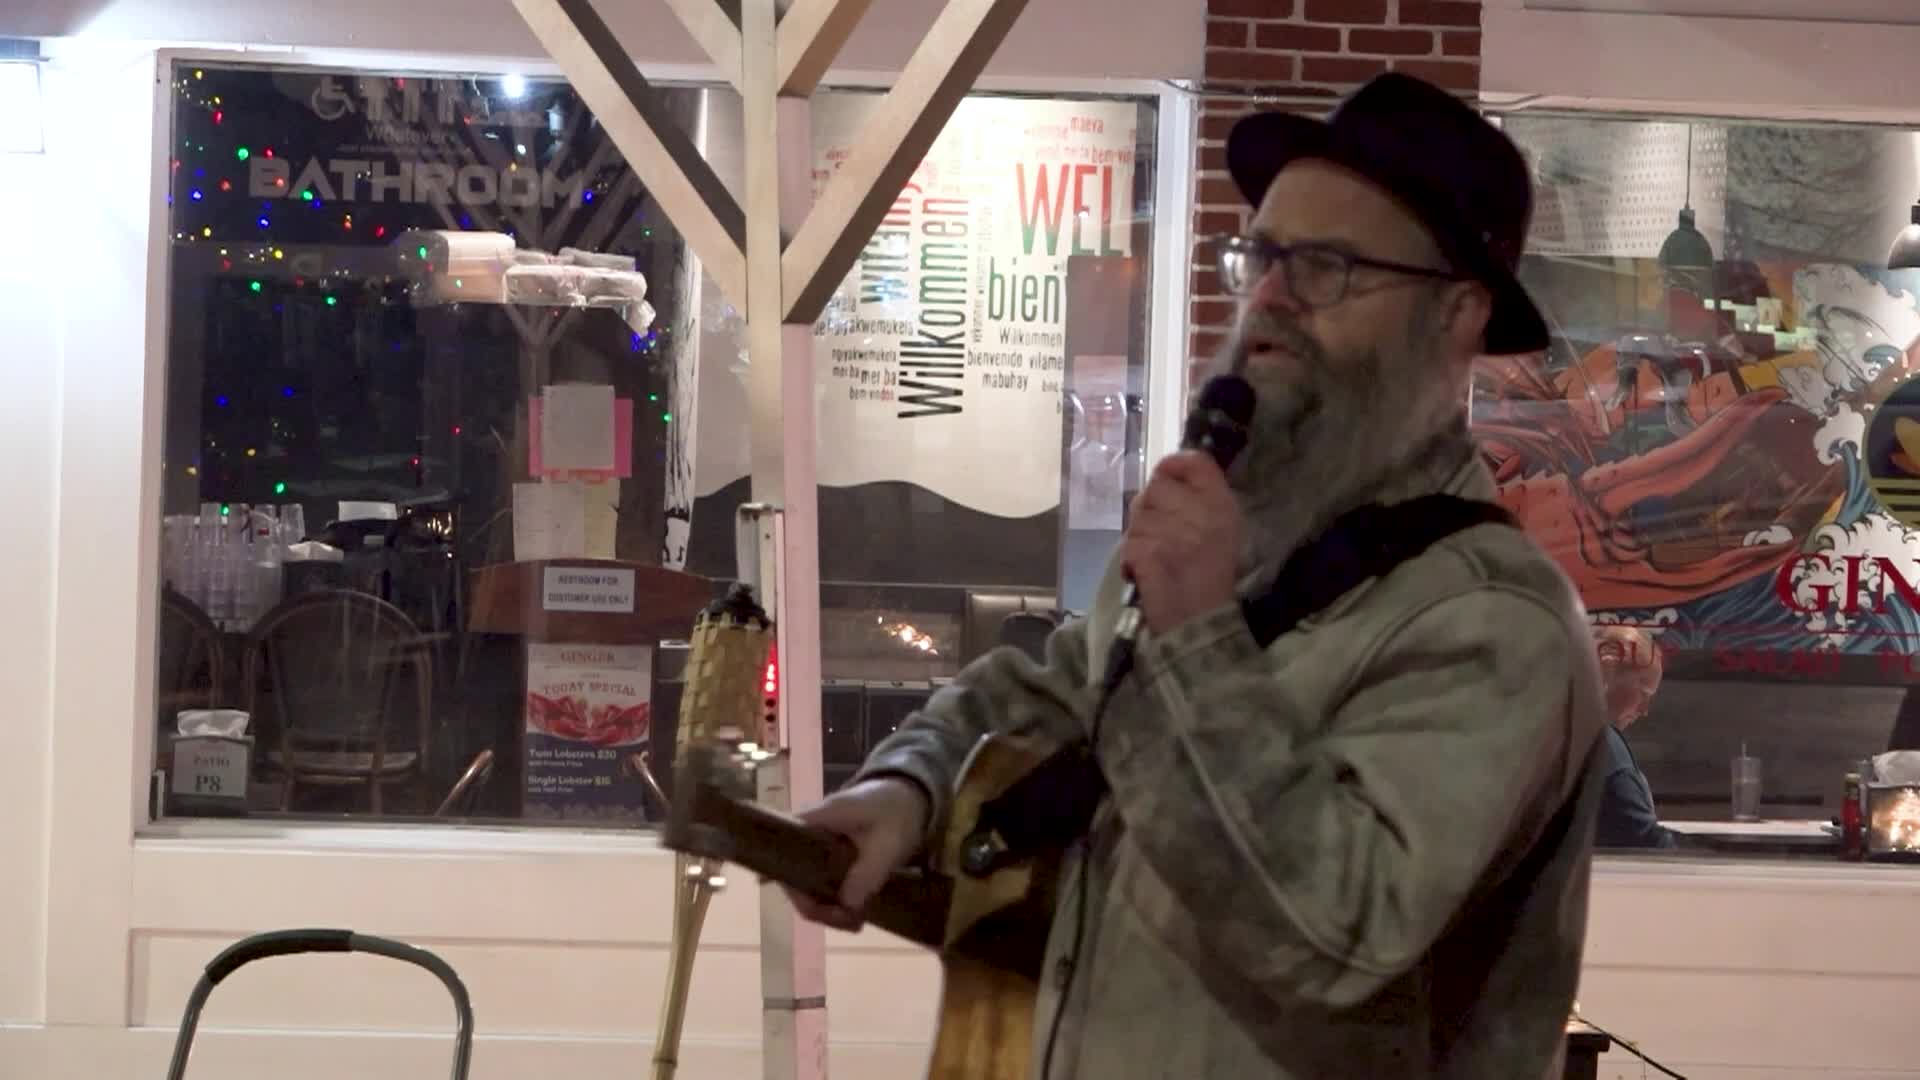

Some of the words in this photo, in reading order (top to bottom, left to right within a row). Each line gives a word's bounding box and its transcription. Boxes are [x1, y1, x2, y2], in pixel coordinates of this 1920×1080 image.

[249, 155, 584, 208] BATHROOM
[1016, 162, 1123, 257] WEL
[897, 197, 968, 419] Willkommen
[988, 255, 1060, 324] bien
[982, 371, 1029, 392] mabuhay
[548, 592, 589, 603] CUSTOMER
[609, 594, 628, 605] ONLY
[558, 574, 600, 585] RESTROOM
[602, 575, 619, 586] FOR
[1775, 553, 1920, 616] GIN
[554, 748, 596, 759] Lobsters
[195, 774, 222, 792] P8
